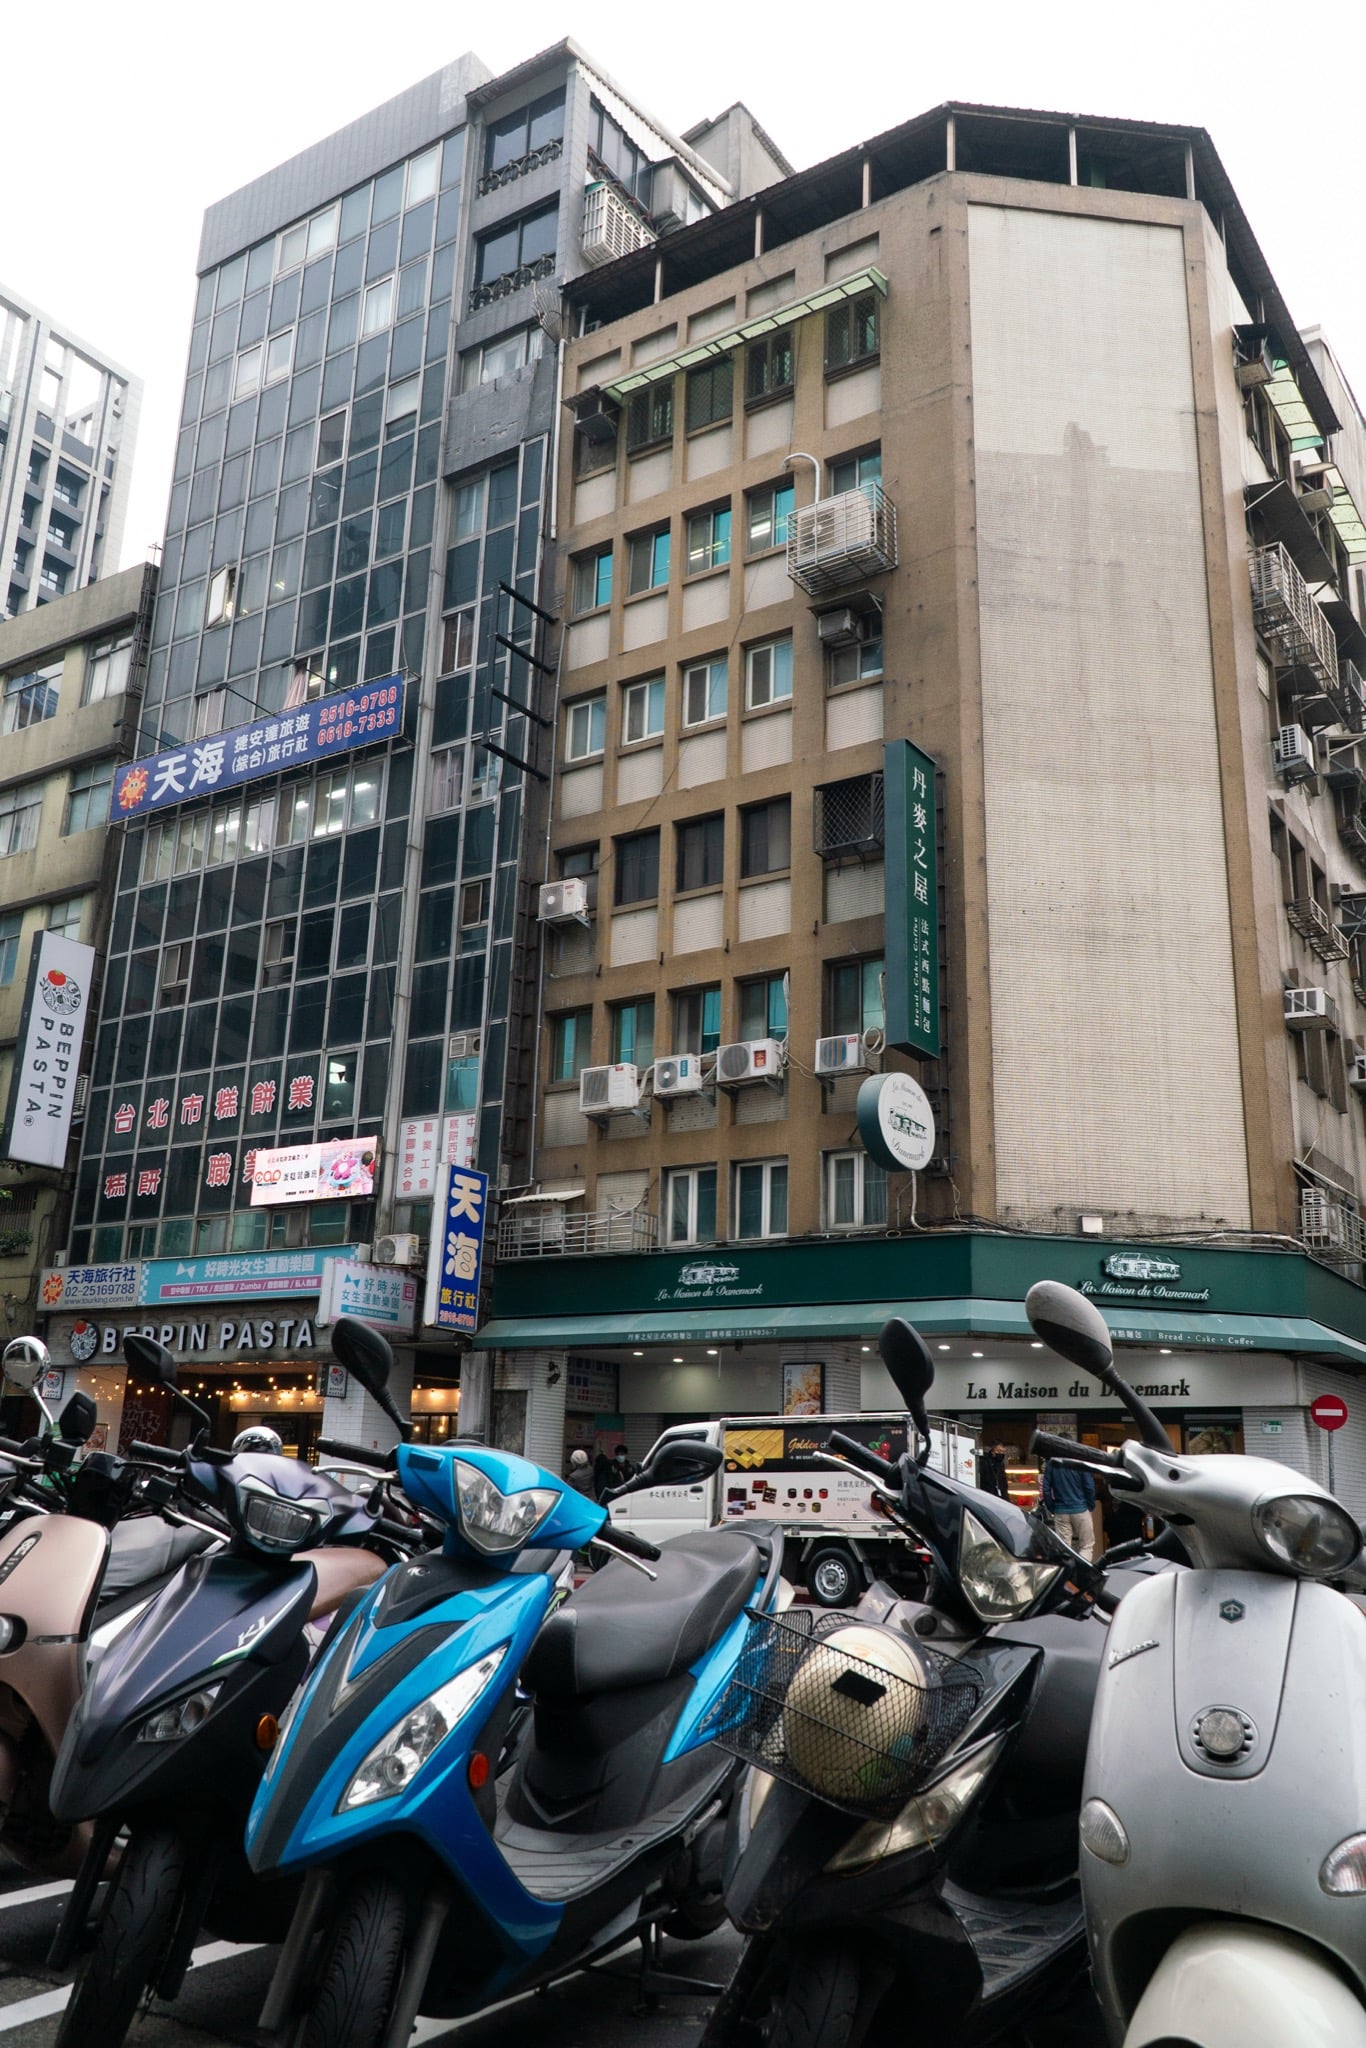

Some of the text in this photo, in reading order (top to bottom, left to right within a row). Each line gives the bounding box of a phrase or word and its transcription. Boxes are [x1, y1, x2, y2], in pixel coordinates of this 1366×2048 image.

[234, 686, 397, 754] 捷安達旅遊 2516-9788
[232, 707, 395, 774] (綜合)旅行社 6618-7333
[151, 740, 226, 801] 天海
[26, 1016, 55, 1113] PASTA
[47, 1022, 75, 1119] BEPPIN
[114, 1075, 315, 1134] 台北市糕餅業
[445, 1173, 482, 1281] 天海
[67, 1266, 136, 1284] 天海旅行社
[65, 1283, 135, 1297] 02-25169788
[364, 1277, 400, 1297] 好時光
[441, 1287, 476, 1310] 旅行社
[702, 1286, 714, 1297] du
[716, 1283, 763, 1297] Danemark
[1094, 1282, 1135, 1296] Maison
[1137, 1284, 1151, 1297] du
[1153, 1285, 1210, 1300] Danemark
[219, 1319, 314, 1350] PASTA
[1158, 1332, 1183, 1342] Bread
[1195, 1334, 1216, 1343] Cake
[1227, 1337, 1255, 1346] Coffee
[965, 1379, 1190, 1399] La Maison du Demark
[788, 1437, 819, 1454] Golden
